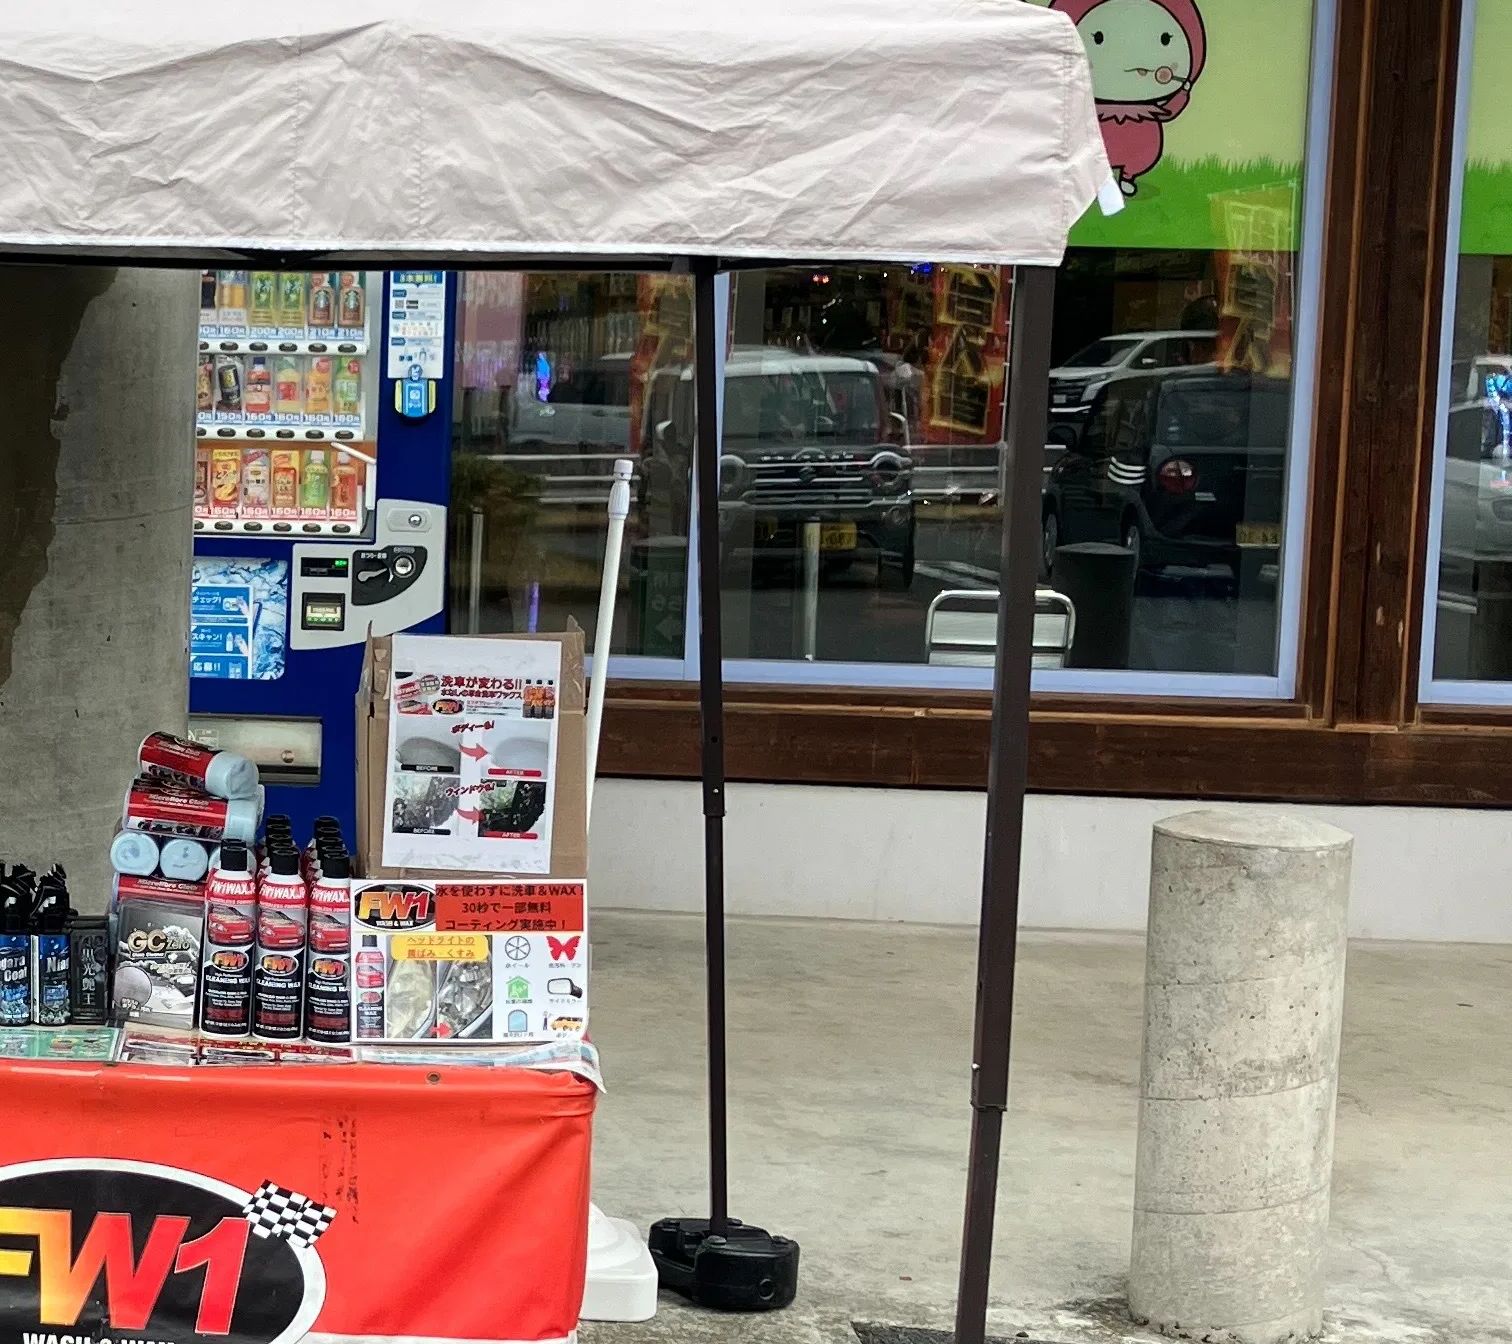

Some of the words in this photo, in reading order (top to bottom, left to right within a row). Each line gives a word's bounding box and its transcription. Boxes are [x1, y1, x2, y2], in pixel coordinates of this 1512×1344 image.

[358, 891, 430, 920] FW1
[461, 901, 552, 914] 30秒で一部無料
[445, 919, 567, 931] コーティング実施中!
[127, 929, 167, 953] GC
[406, 935, 475, 946] ヘッドライトの
[3, 967, 28, 982] Coat
